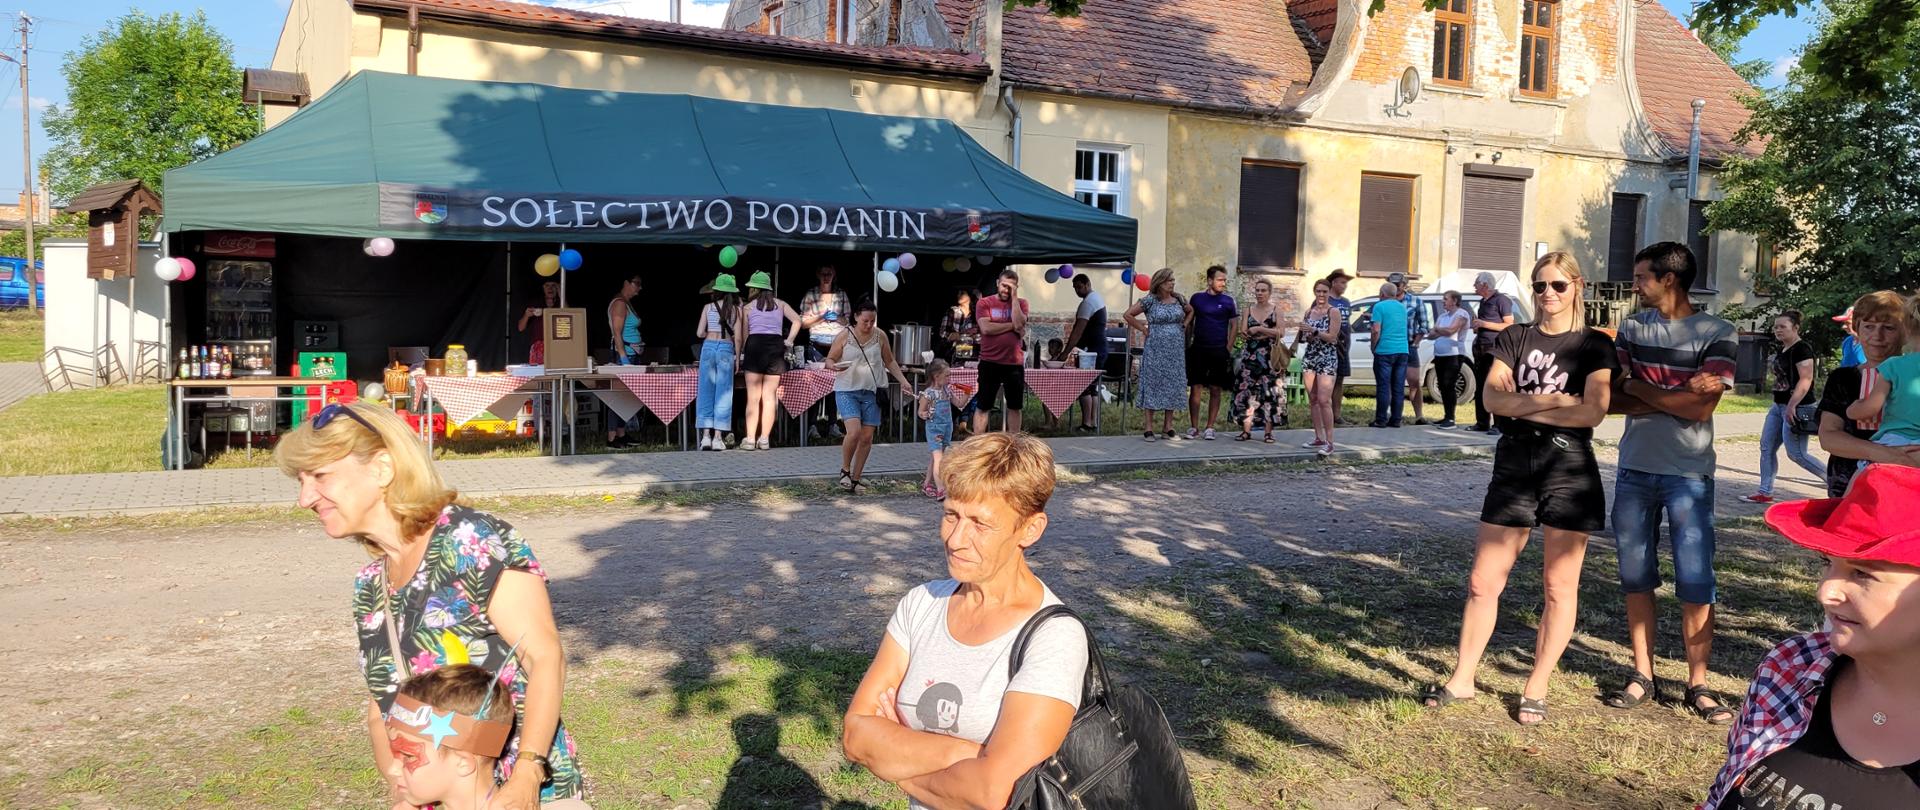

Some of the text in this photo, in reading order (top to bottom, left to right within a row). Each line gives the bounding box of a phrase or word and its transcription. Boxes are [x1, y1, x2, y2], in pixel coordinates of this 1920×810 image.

[482, 196, 927, 240] SOŁECTWO PODANIN
[1527, 349, 1556, 370] OH
[314, 367, 334, 377] LECH
[1518, 363, 1540, 387] LA
[1543, 364, 1569, 390] LA
